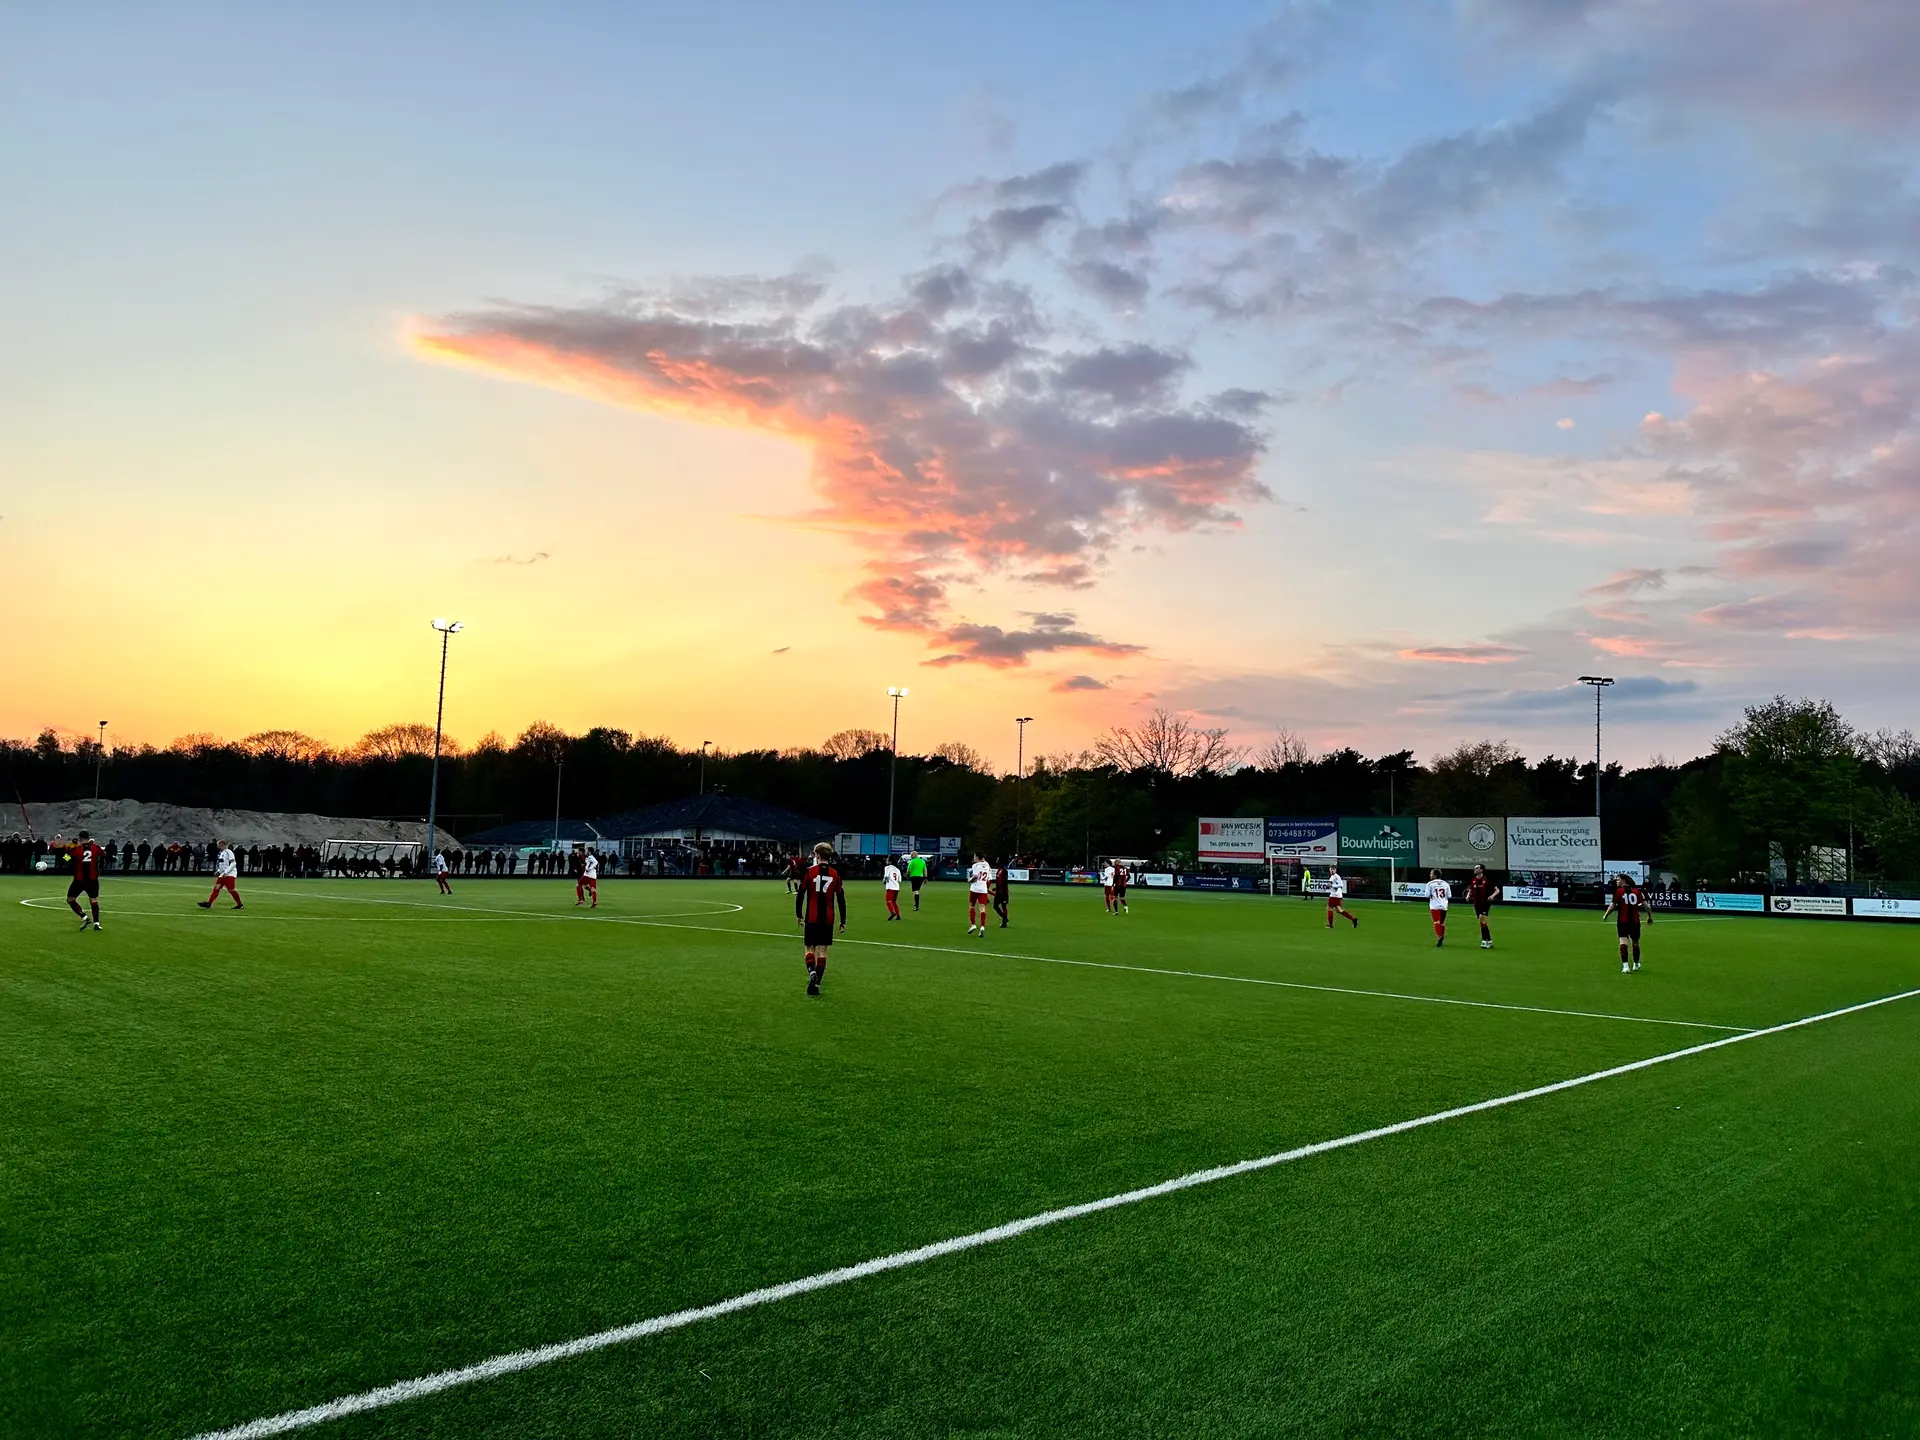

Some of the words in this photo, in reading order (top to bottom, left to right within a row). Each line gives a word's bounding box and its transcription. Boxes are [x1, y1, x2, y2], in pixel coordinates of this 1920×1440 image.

[1268, 829, 1317, 837] 073-6488750
[1516, 826, 1590, 837] Uitvaartverzorging
[1341, 836, 1414, 851] Bouwhuijsen
[1510, 834, 1536, 846] Van
[1536, 834, 1560, 846] der
[1560, 834, 1599, 846] Steen
[82, 850, 92, 862] 2
[1269, 846, 1311, 856] RSP
[1119, 868, 1127, 876] 21
[813, 875, 834, 893] 17
[1435, 888, 1446, 898] 13
[1622, 893, 1638, 905] 10
